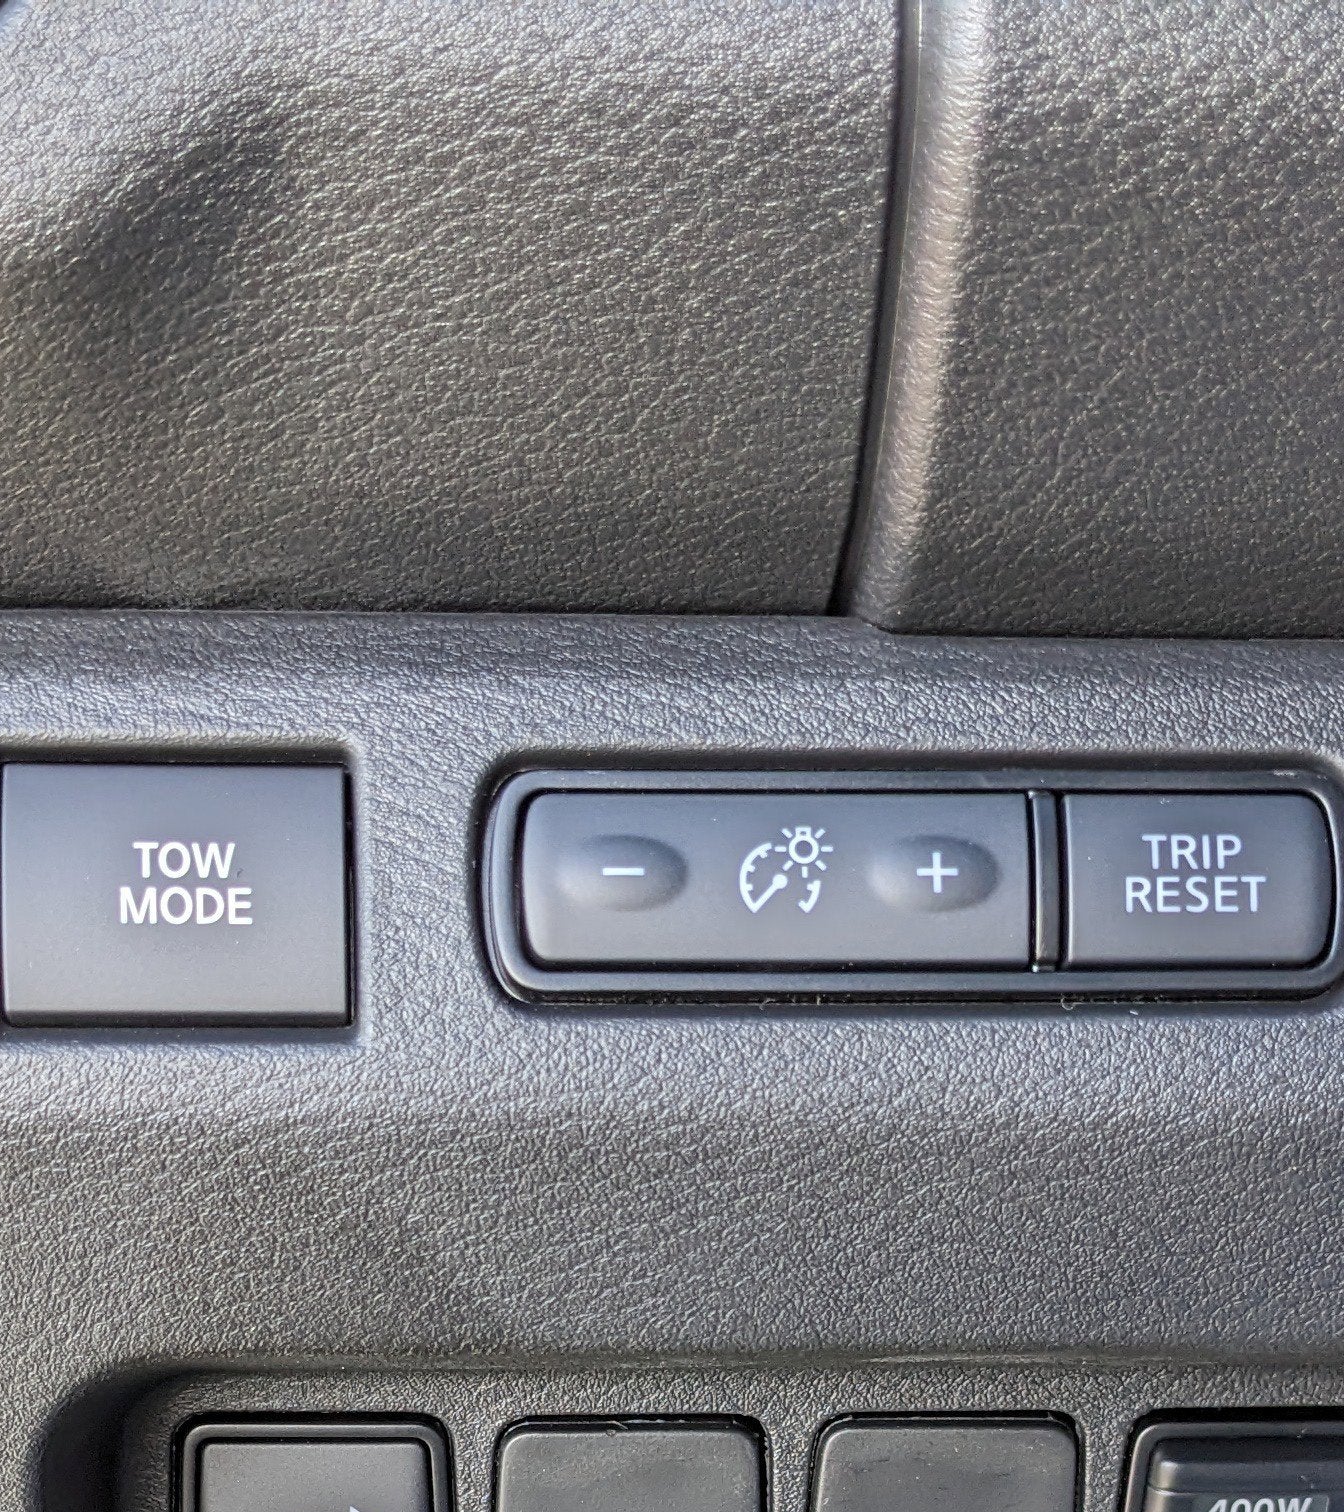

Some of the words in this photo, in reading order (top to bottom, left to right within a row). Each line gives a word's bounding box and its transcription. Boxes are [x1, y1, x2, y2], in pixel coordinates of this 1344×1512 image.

[132, 840, 236, 879] TOW
[1139, 833, 1242, 871] TRIP
[118, 886, 254, 925] MODE
[1123, 875, 1267, 914] RESET
